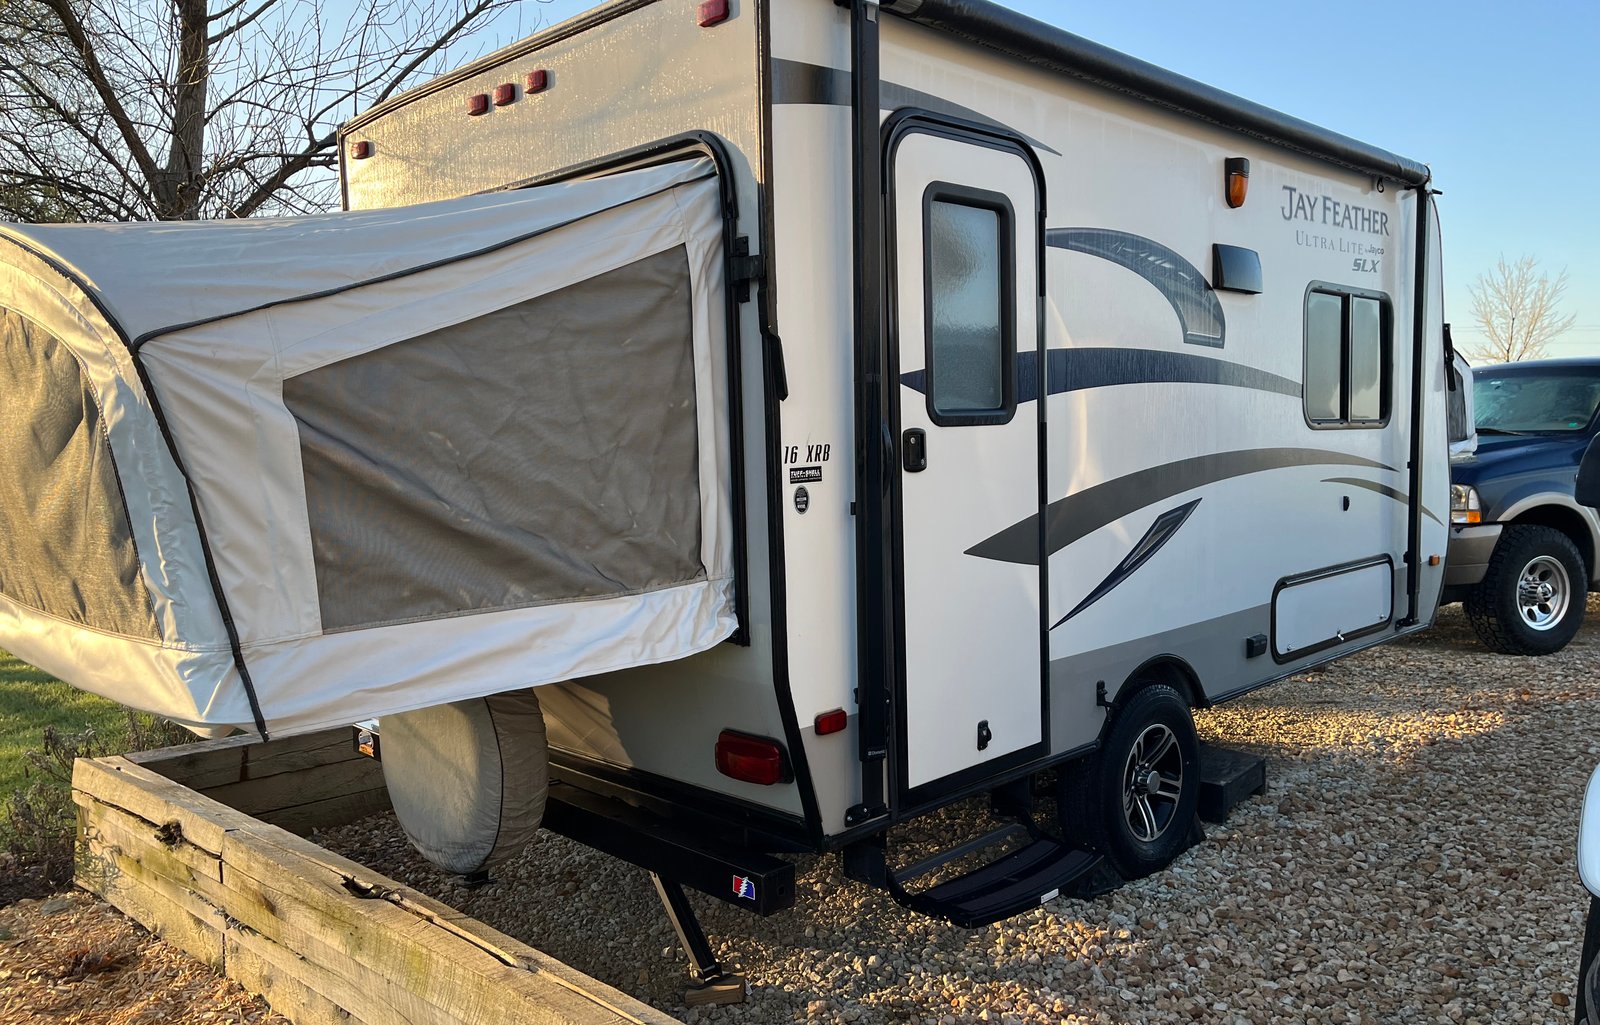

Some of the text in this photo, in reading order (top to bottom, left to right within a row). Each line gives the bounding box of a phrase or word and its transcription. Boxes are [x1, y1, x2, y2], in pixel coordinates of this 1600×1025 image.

[1281, 185, 1389, 236] JAY FEATHER
[1296, 230, 1335, 251] ULTRA
[1339, 237, 1364, 255] LITE
[1352, 258, 1380, 273] SLX
[784, 444, 831, 464] 16 XRB
